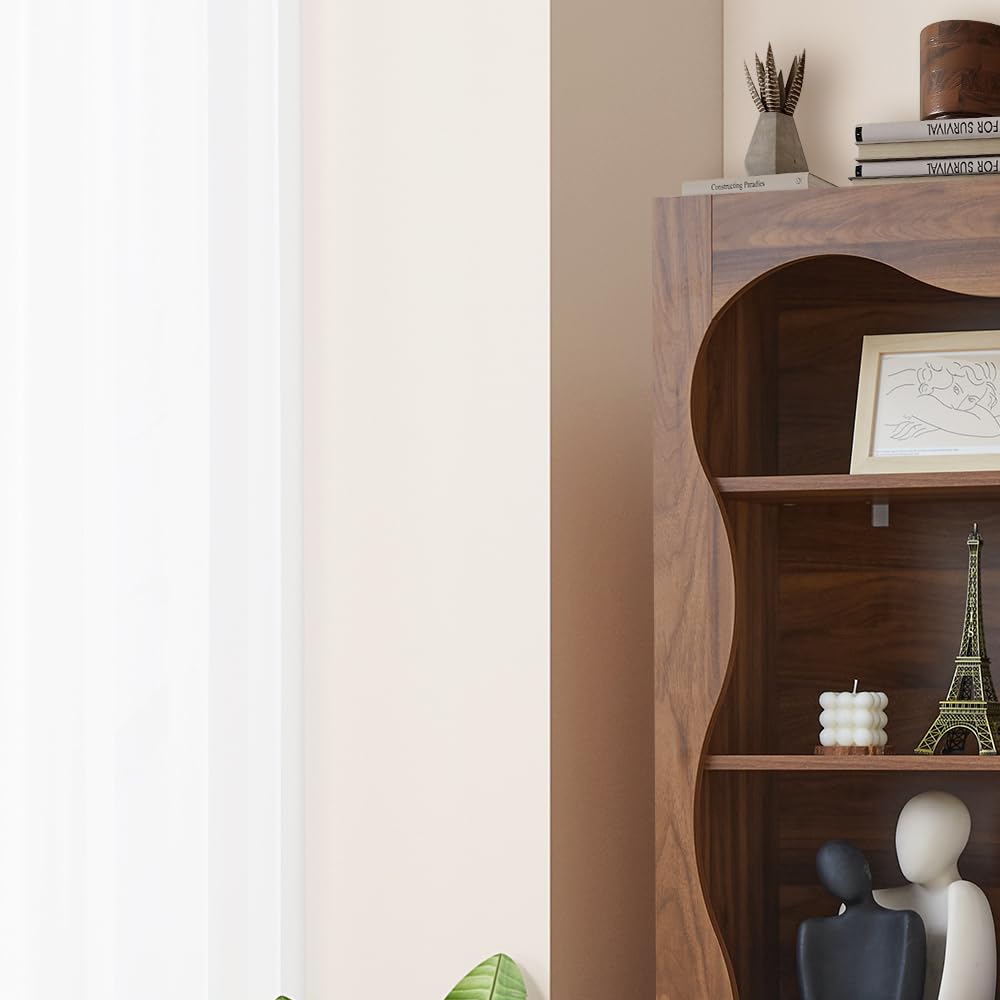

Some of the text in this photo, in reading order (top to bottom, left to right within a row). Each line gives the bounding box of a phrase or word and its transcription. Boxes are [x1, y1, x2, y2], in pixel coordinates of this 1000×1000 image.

[928, 121, 974, 136] SURVIVAL
[978, 121, 998, 133] FOR
[926, 161, 974, 175] SURVIVAL
[978, 161, 998, 172] FOR
